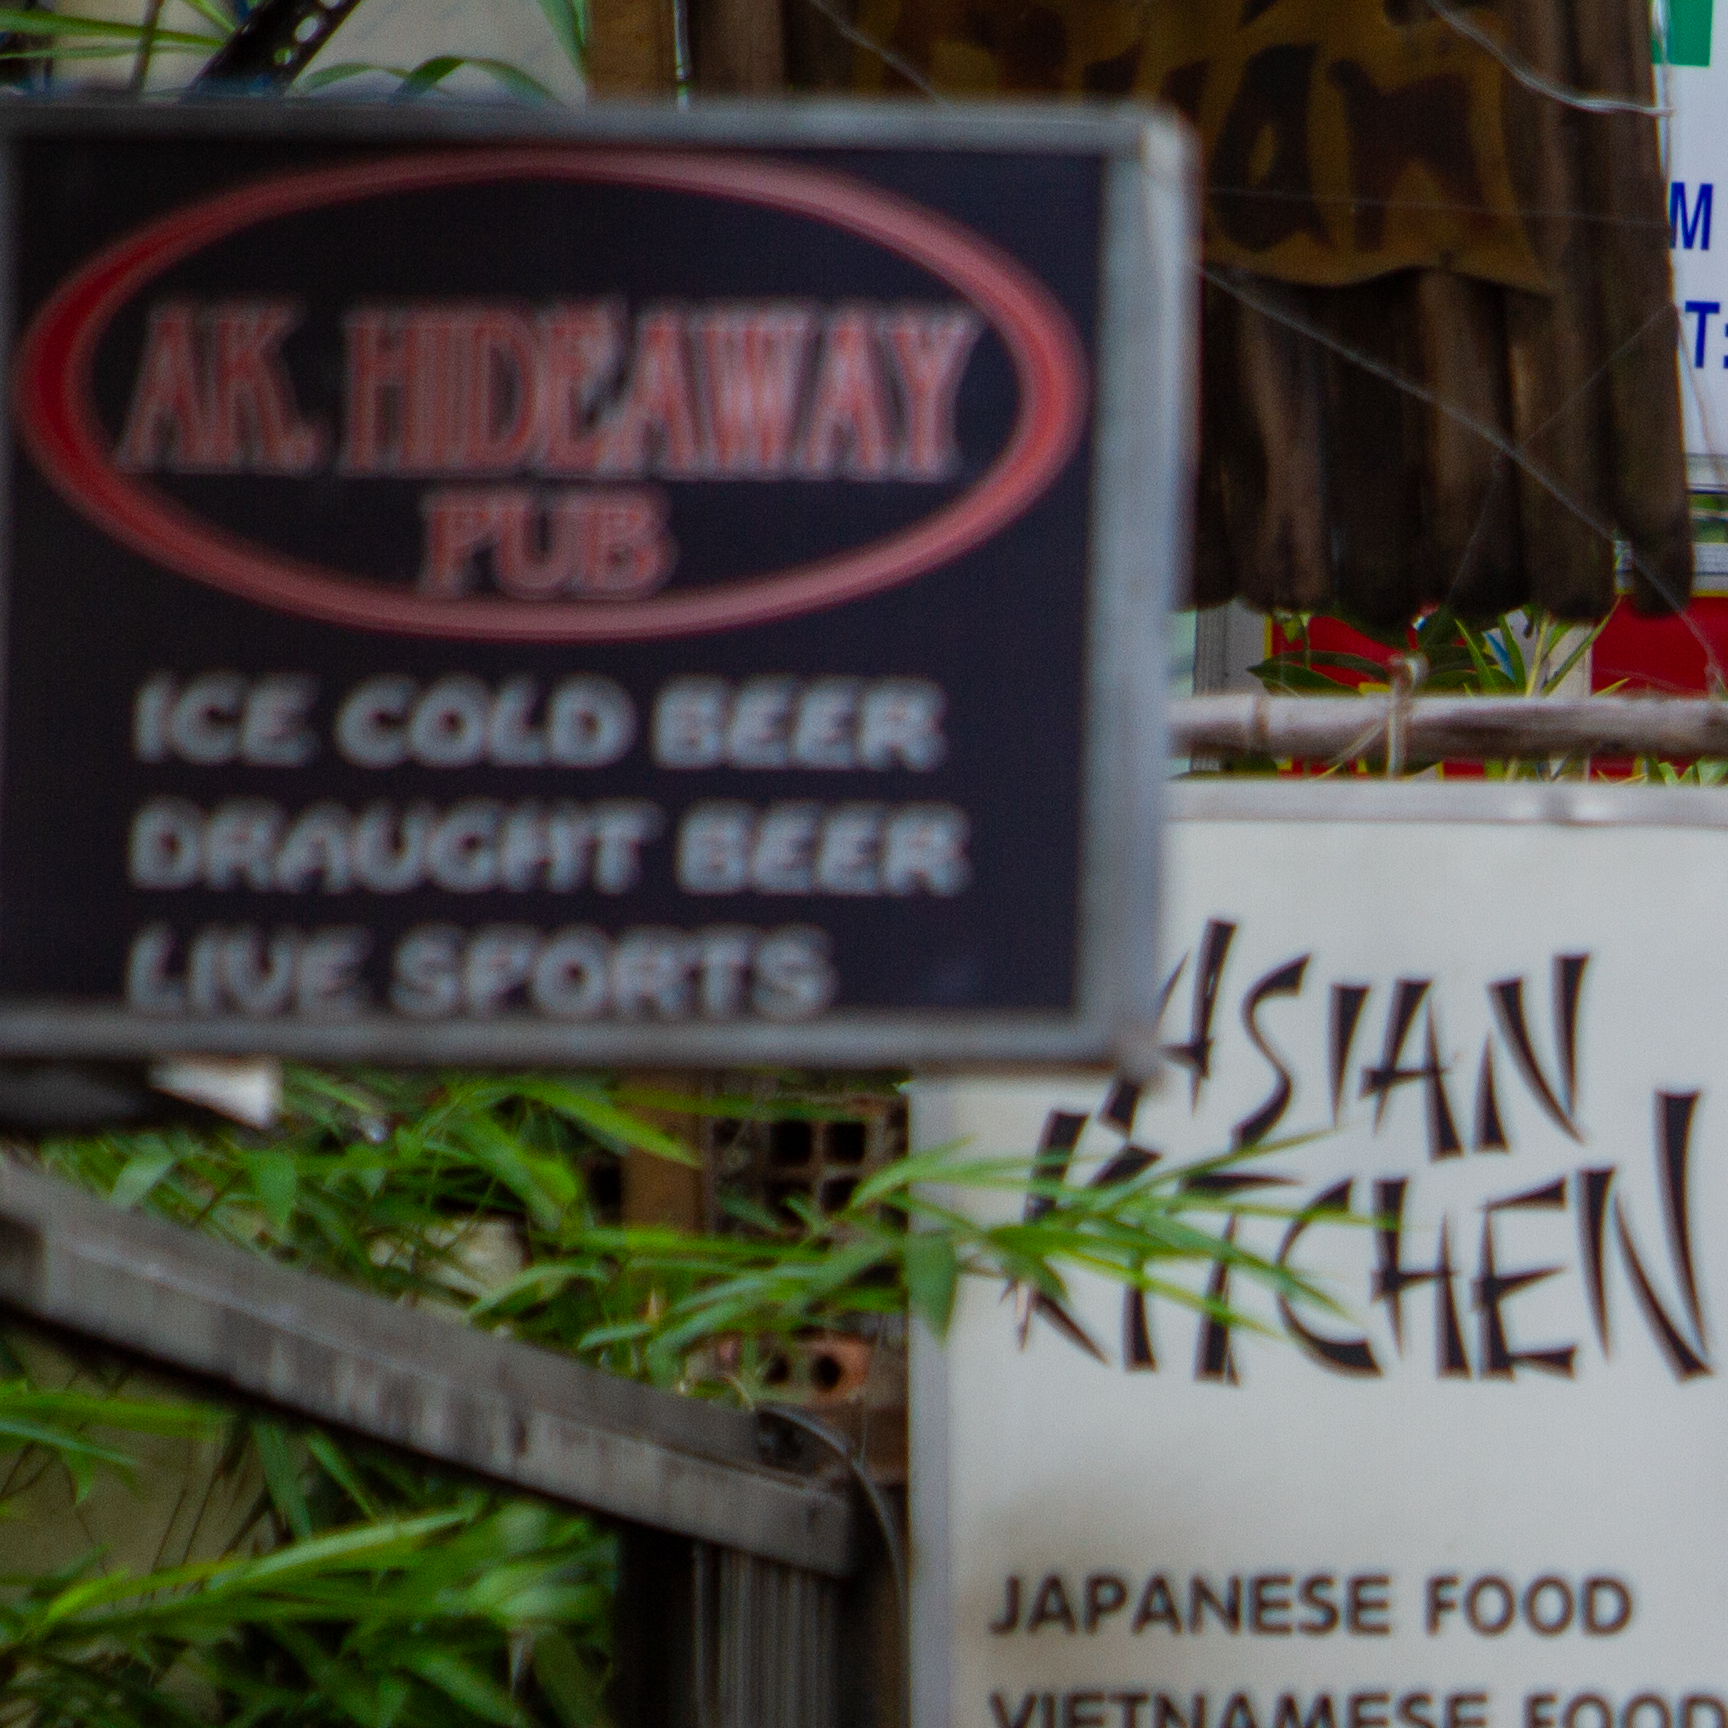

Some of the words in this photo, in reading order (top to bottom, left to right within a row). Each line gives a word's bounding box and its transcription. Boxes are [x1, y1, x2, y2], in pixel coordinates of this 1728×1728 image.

[340, 300, 980, 479] HIDEAWAY
[418, 490, 672, 597] PUB
[134, 672, 315, 764] ICE
[335, 672, 635, 767] COLD
[652, 675, 947, 770] BEER
[128, 799, 660, 889] DRAUGHT
[678, 804, 970, 894] BEER
[126, 924, 374, 1014] LIVE
[394, 926, 835, 1016] SPORTS
[1103, 919, 1593, 1162] ASIAN
[1001, 1088, 1715, 1386] KITCHEN
[989, 1573, 1392, 1636] JAPANESE
[1425, 1575, 1633, 1636] FOOD
